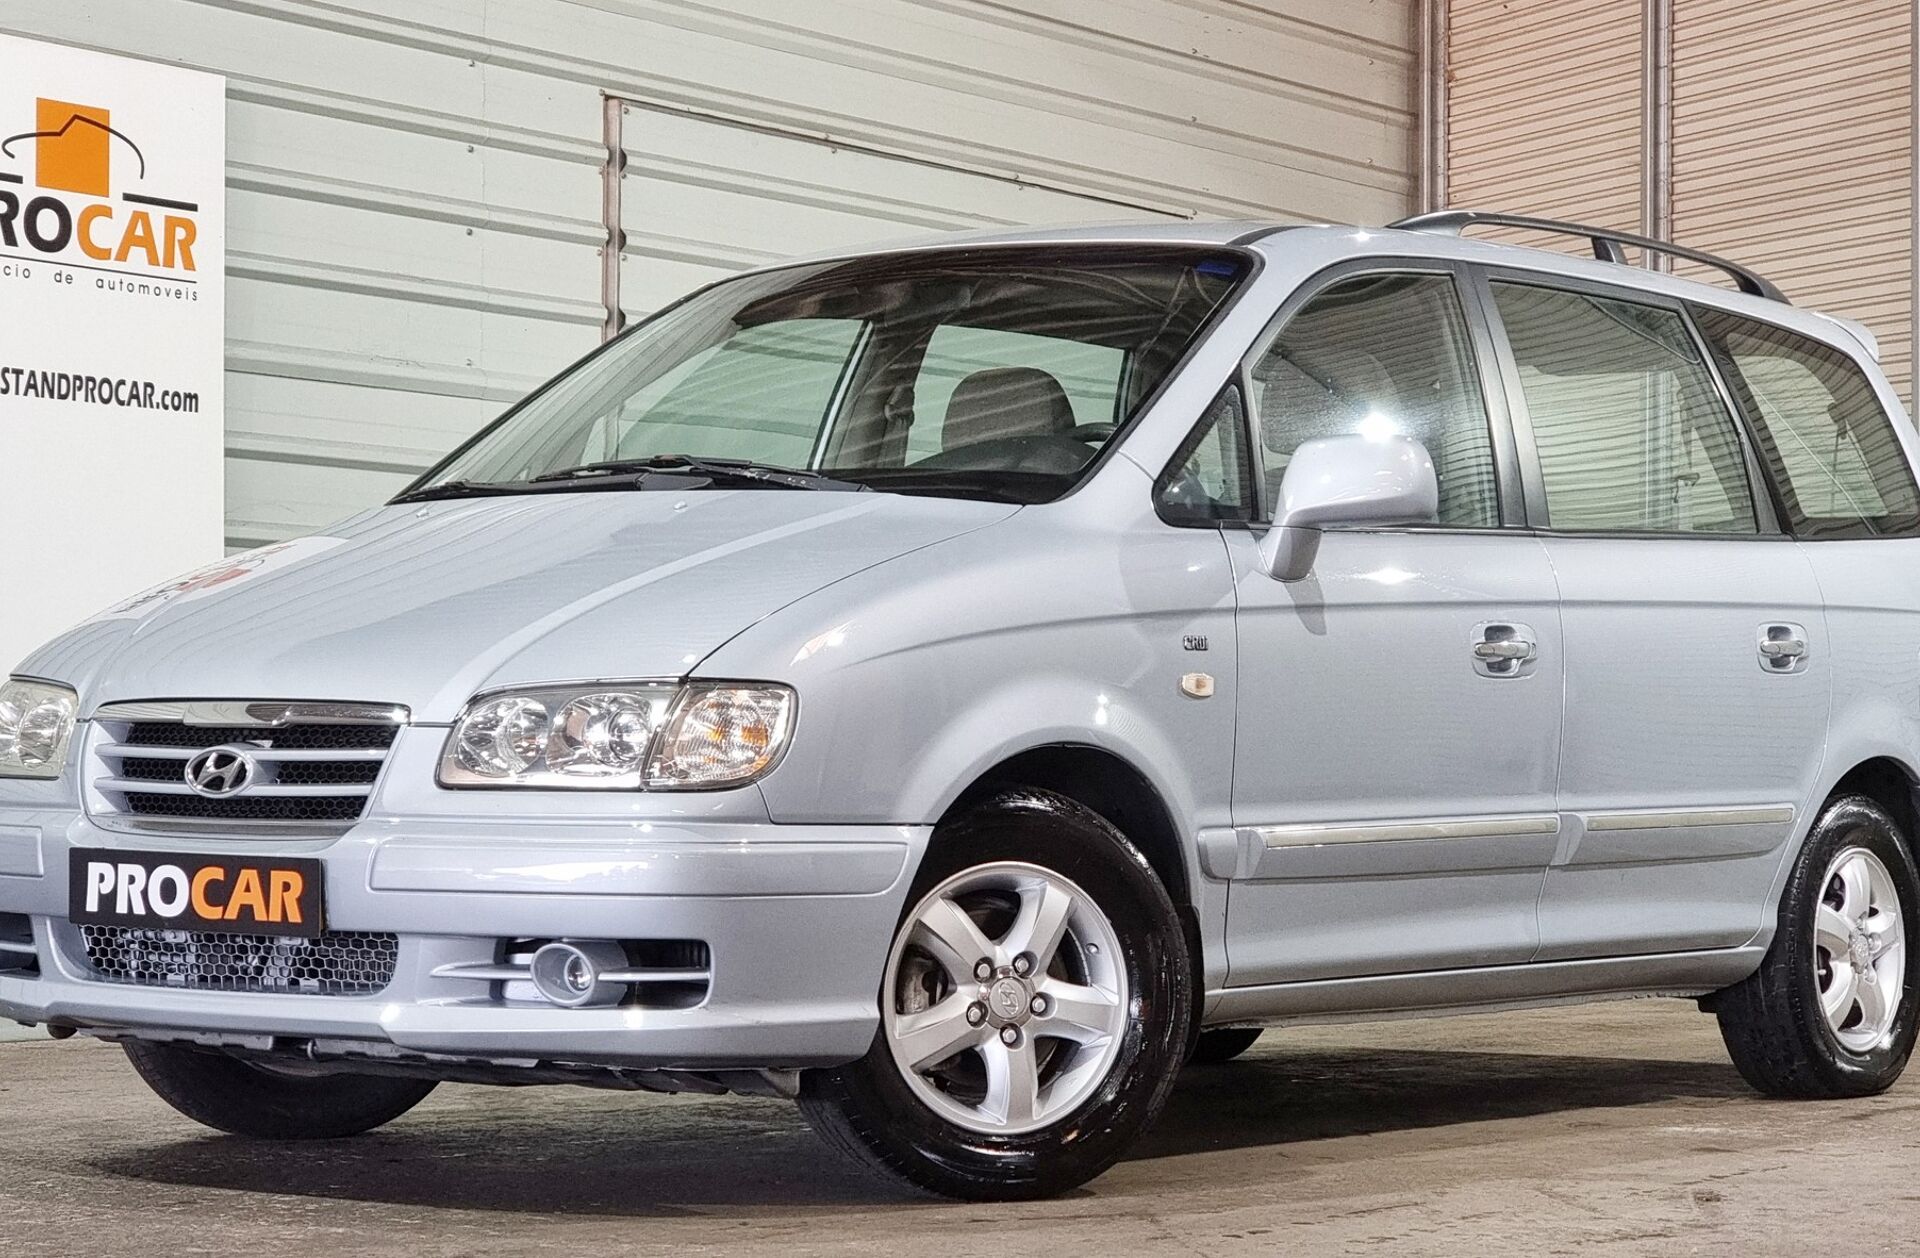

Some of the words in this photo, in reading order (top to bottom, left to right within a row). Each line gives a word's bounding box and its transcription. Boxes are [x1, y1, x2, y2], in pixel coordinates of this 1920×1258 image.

[3, 264, 31, 279] cio
[54, 269, 73, 285] de
[95, 278, 198, 301] automoveis
[0, 366, 199, 413] STANDPROCAR.com
[85, 861, 304, 924] PROCAR
